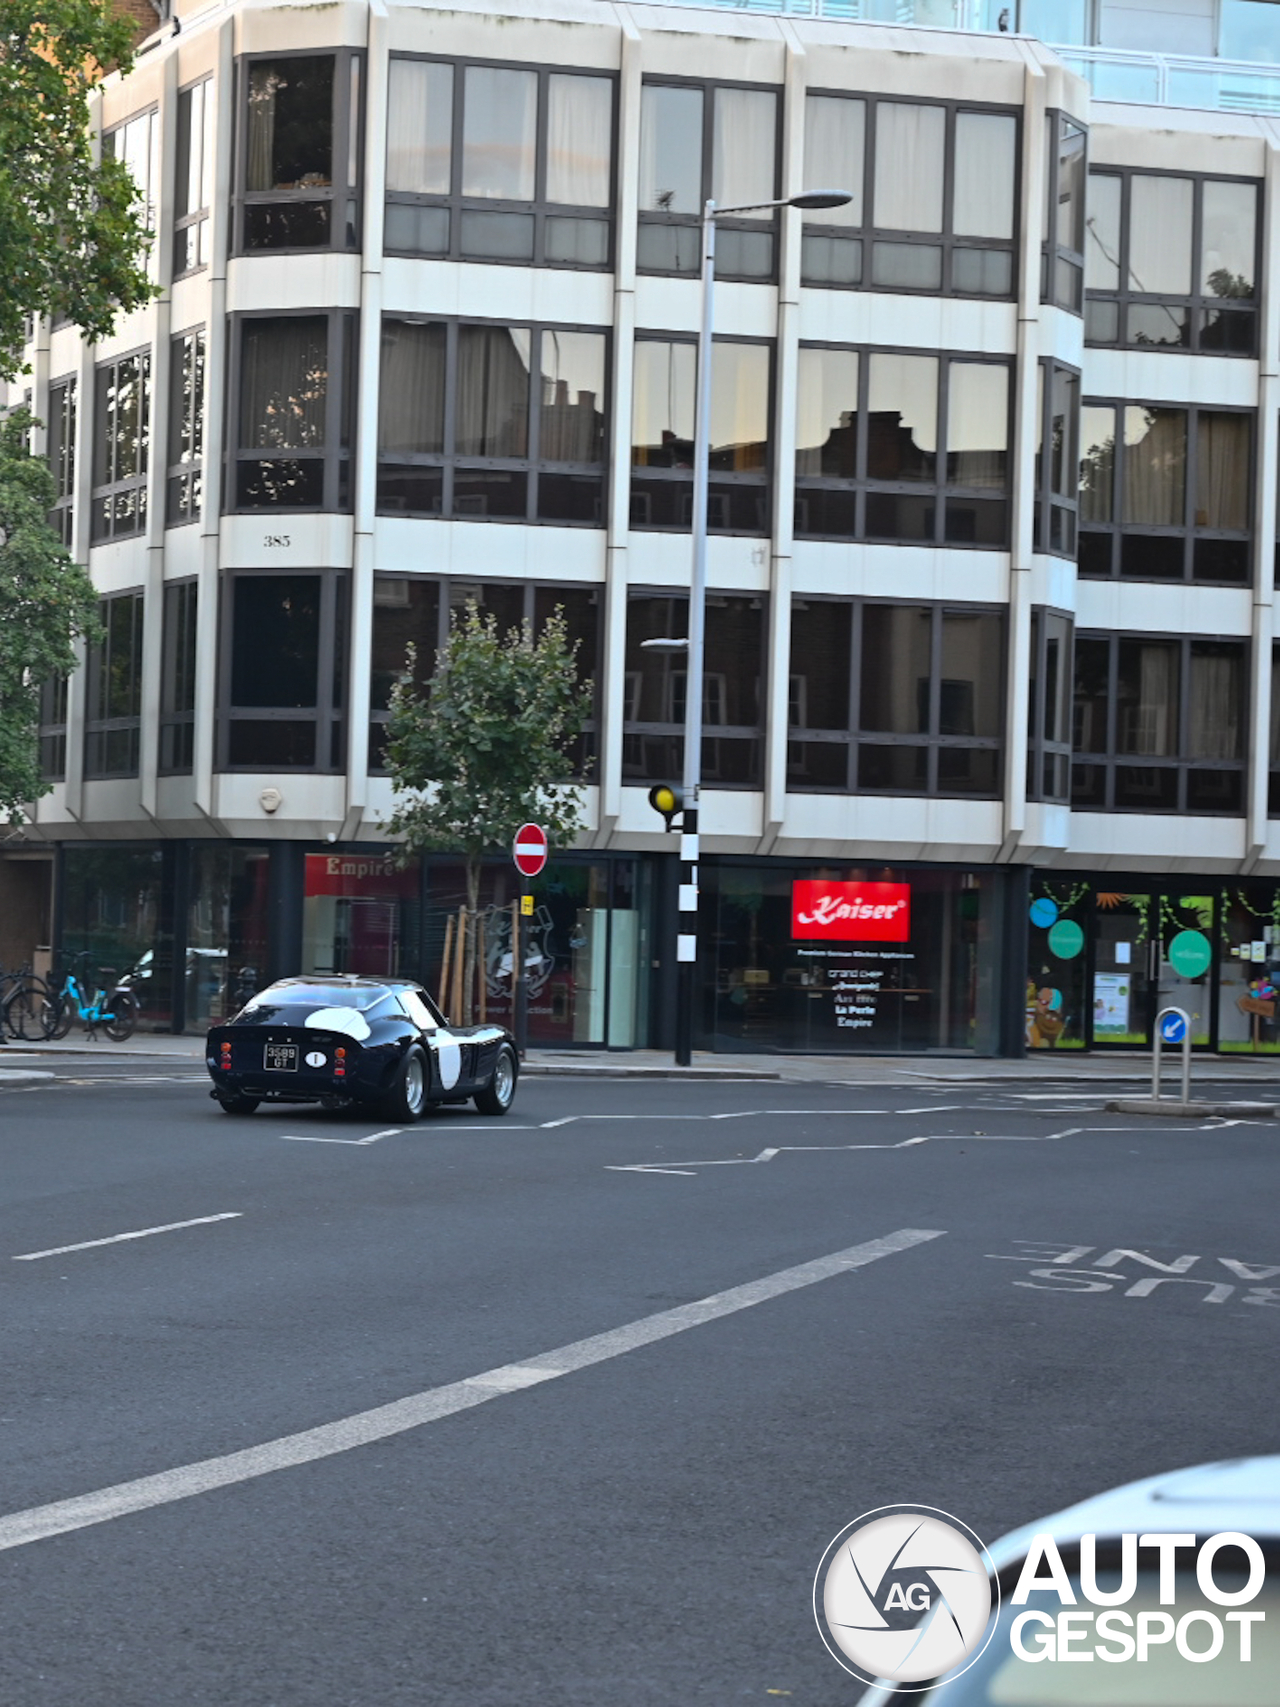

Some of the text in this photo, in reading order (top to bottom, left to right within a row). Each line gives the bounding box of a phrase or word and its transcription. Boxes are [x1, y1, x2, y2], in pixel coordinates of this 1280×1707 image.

[263, 535, 291, 548] 385
[326, 857, 394, 880] Empire
[834, 1004, 877, 1016] La Perle
[837, 1016, 873, 1029] Empire
[273, 1058, 288, 1068] GT
